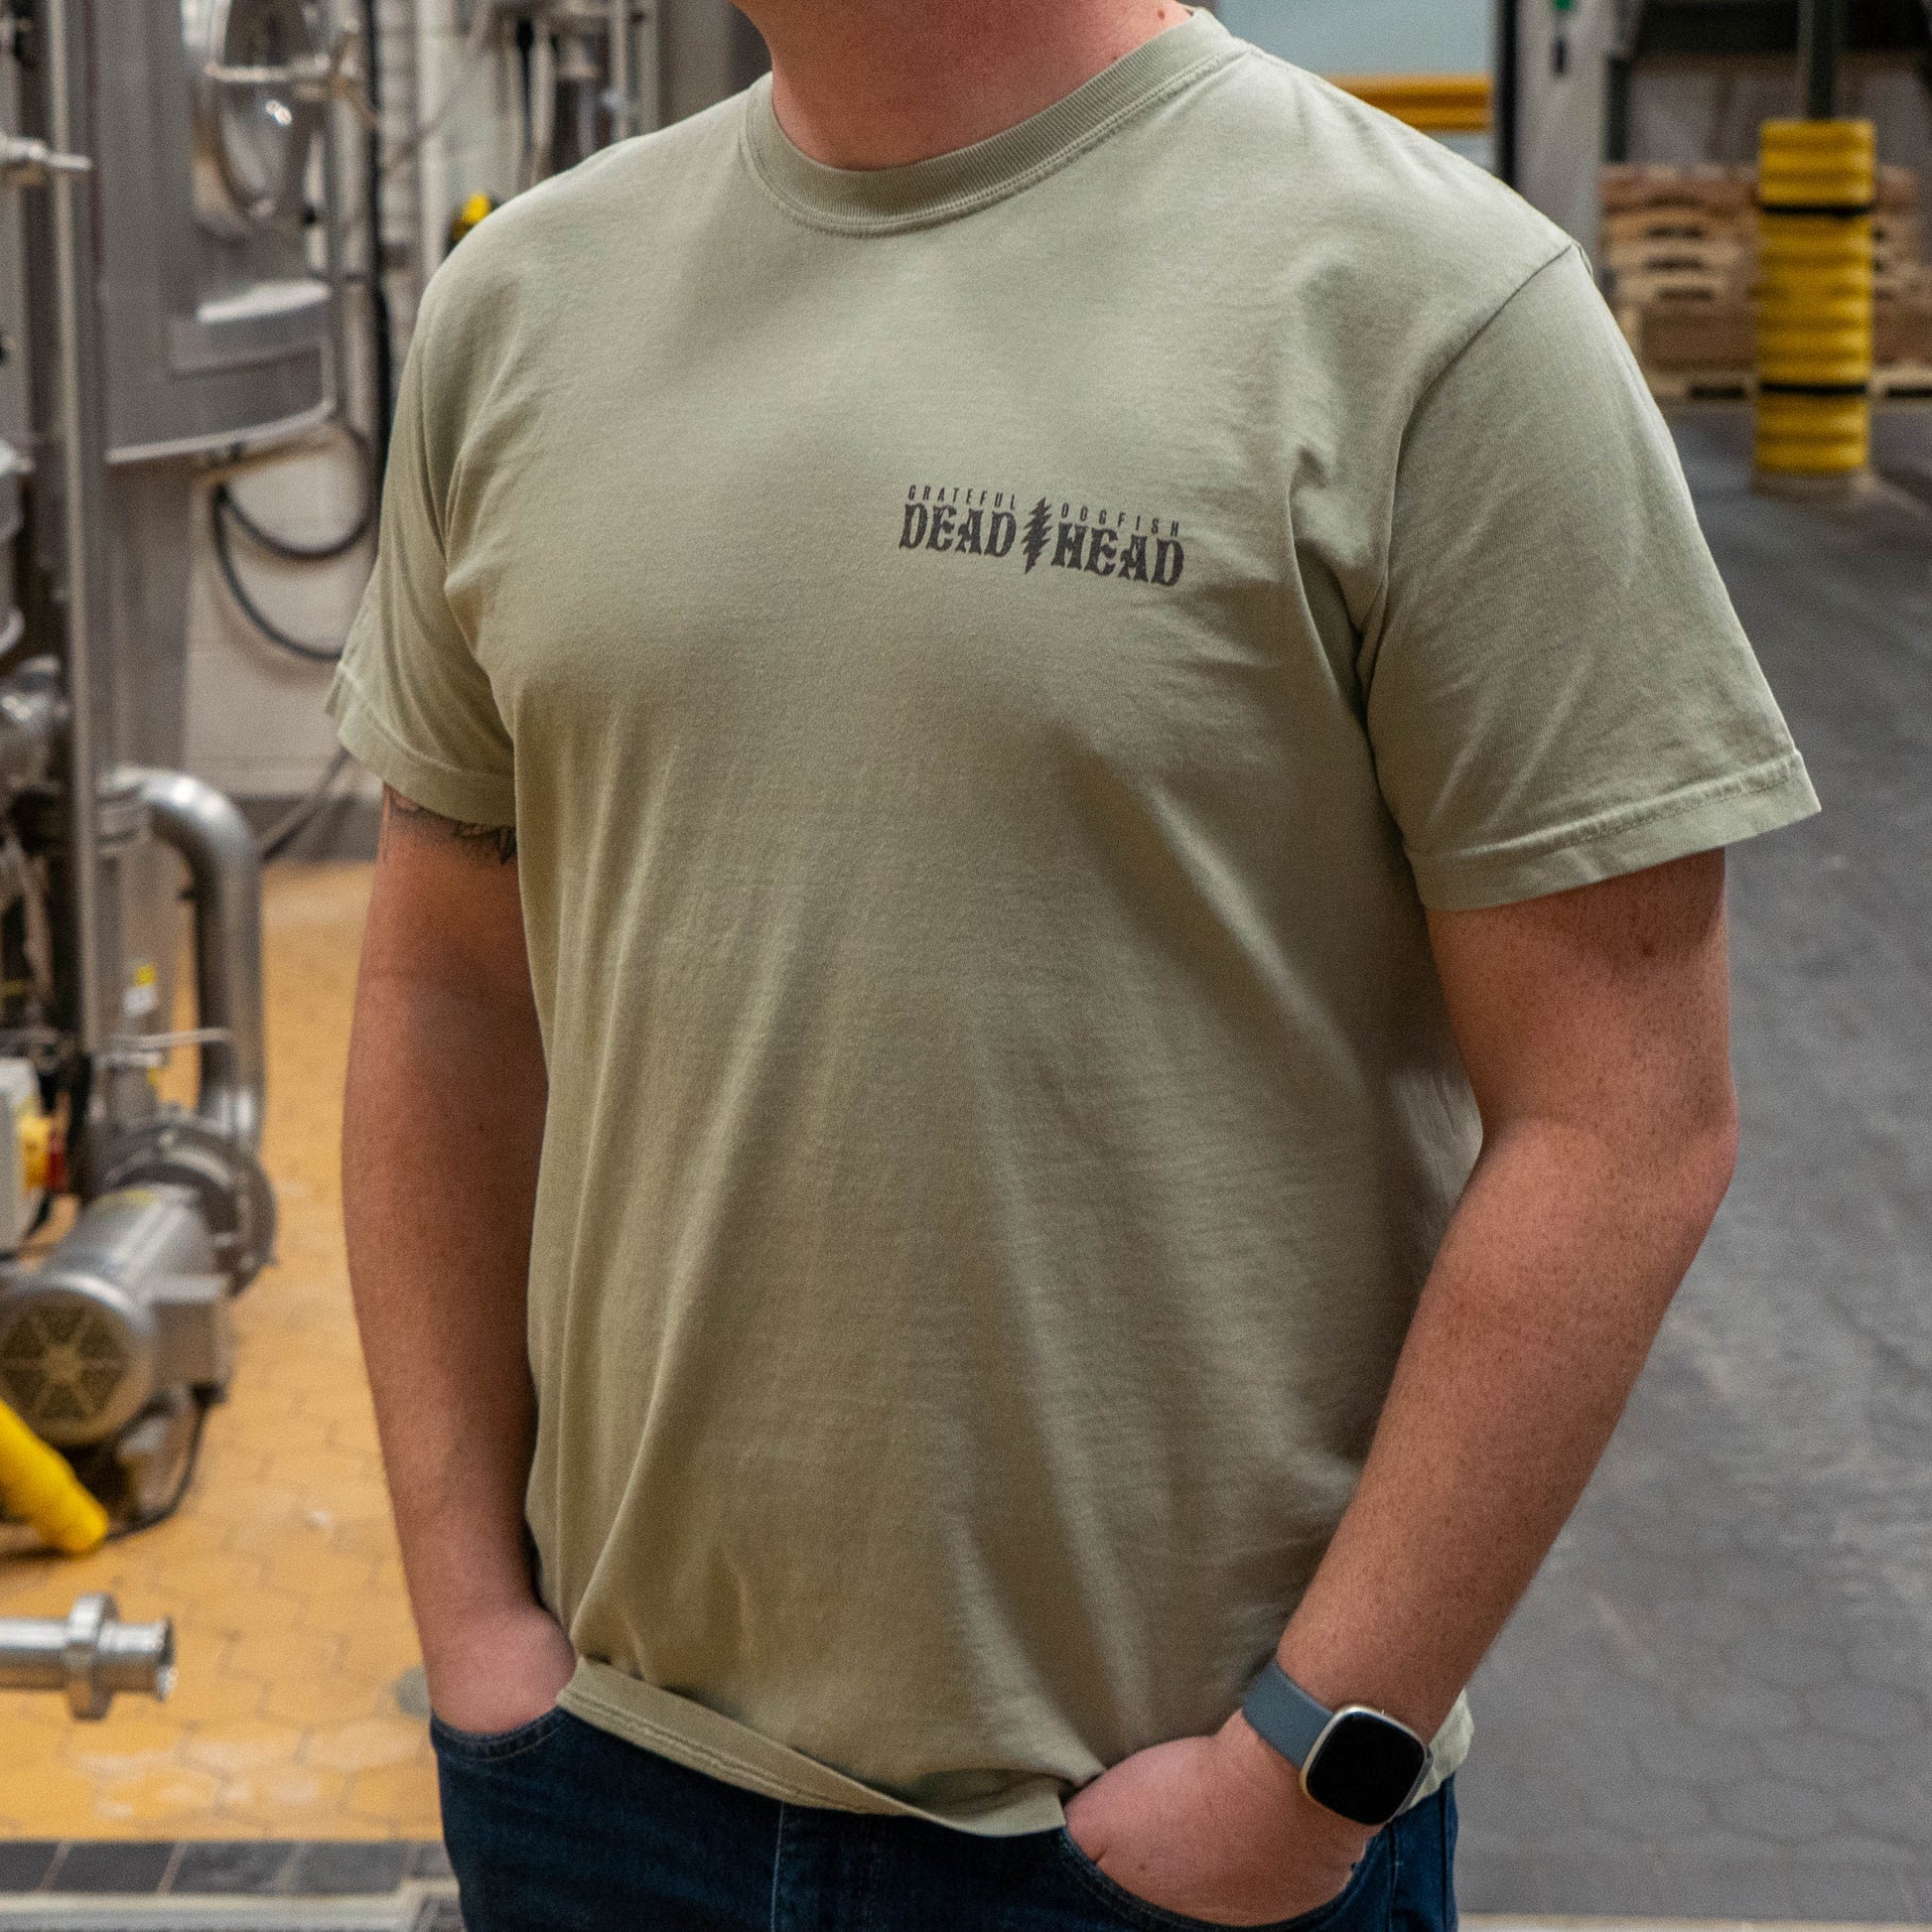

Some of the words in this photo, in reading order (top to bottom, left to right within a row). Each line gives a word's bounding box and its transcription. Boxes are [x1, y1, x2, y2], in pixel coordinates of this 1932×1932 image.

[898, 502, 1017, 558] DEAD
[1050, 521, 1184, 587] HEAD
[907, 484, 1016, 510] GRATEFUL
[1060, 502, 1179, 537] DOGFISH
